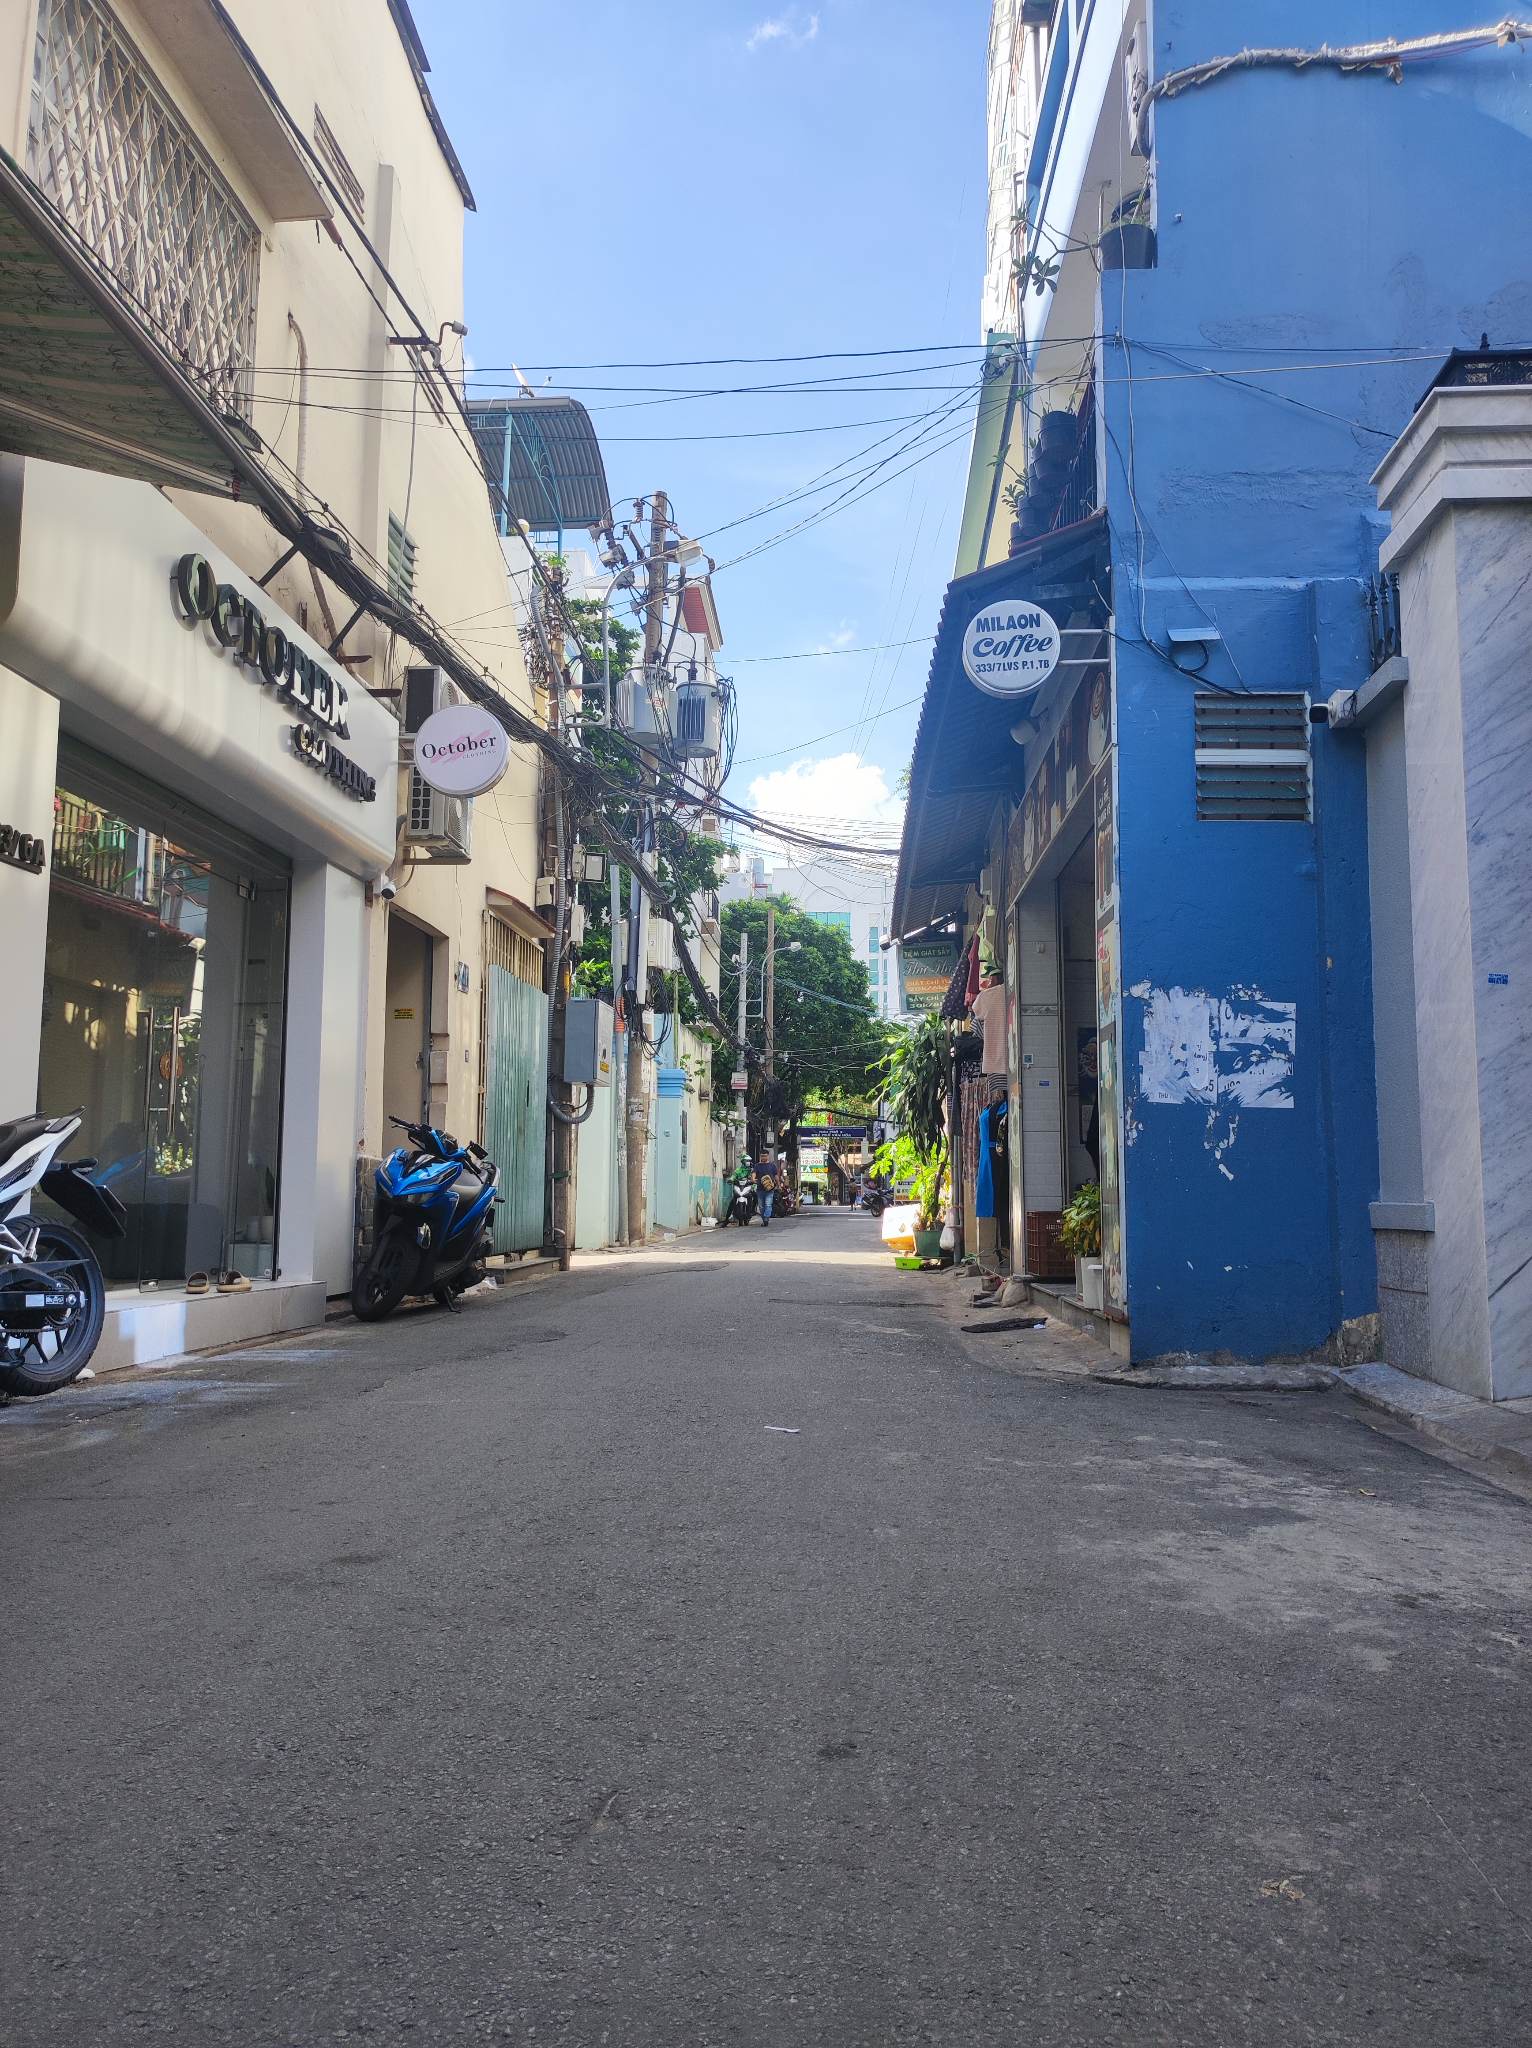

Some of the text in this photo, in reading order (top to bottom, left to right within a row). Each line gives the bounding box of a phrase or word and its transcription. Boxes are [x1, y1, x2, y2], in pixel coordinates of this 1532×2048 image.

[976, 613, 1041, 633] MILAON
[177, 553, 350, 740] OCTOBER
[972, 633, 1053, 659] Coffee
[422, 736, 497, 758] October
[462, 750, 497, 760] CLOTHING
[294, 723, 377, 802] CLOTHING
